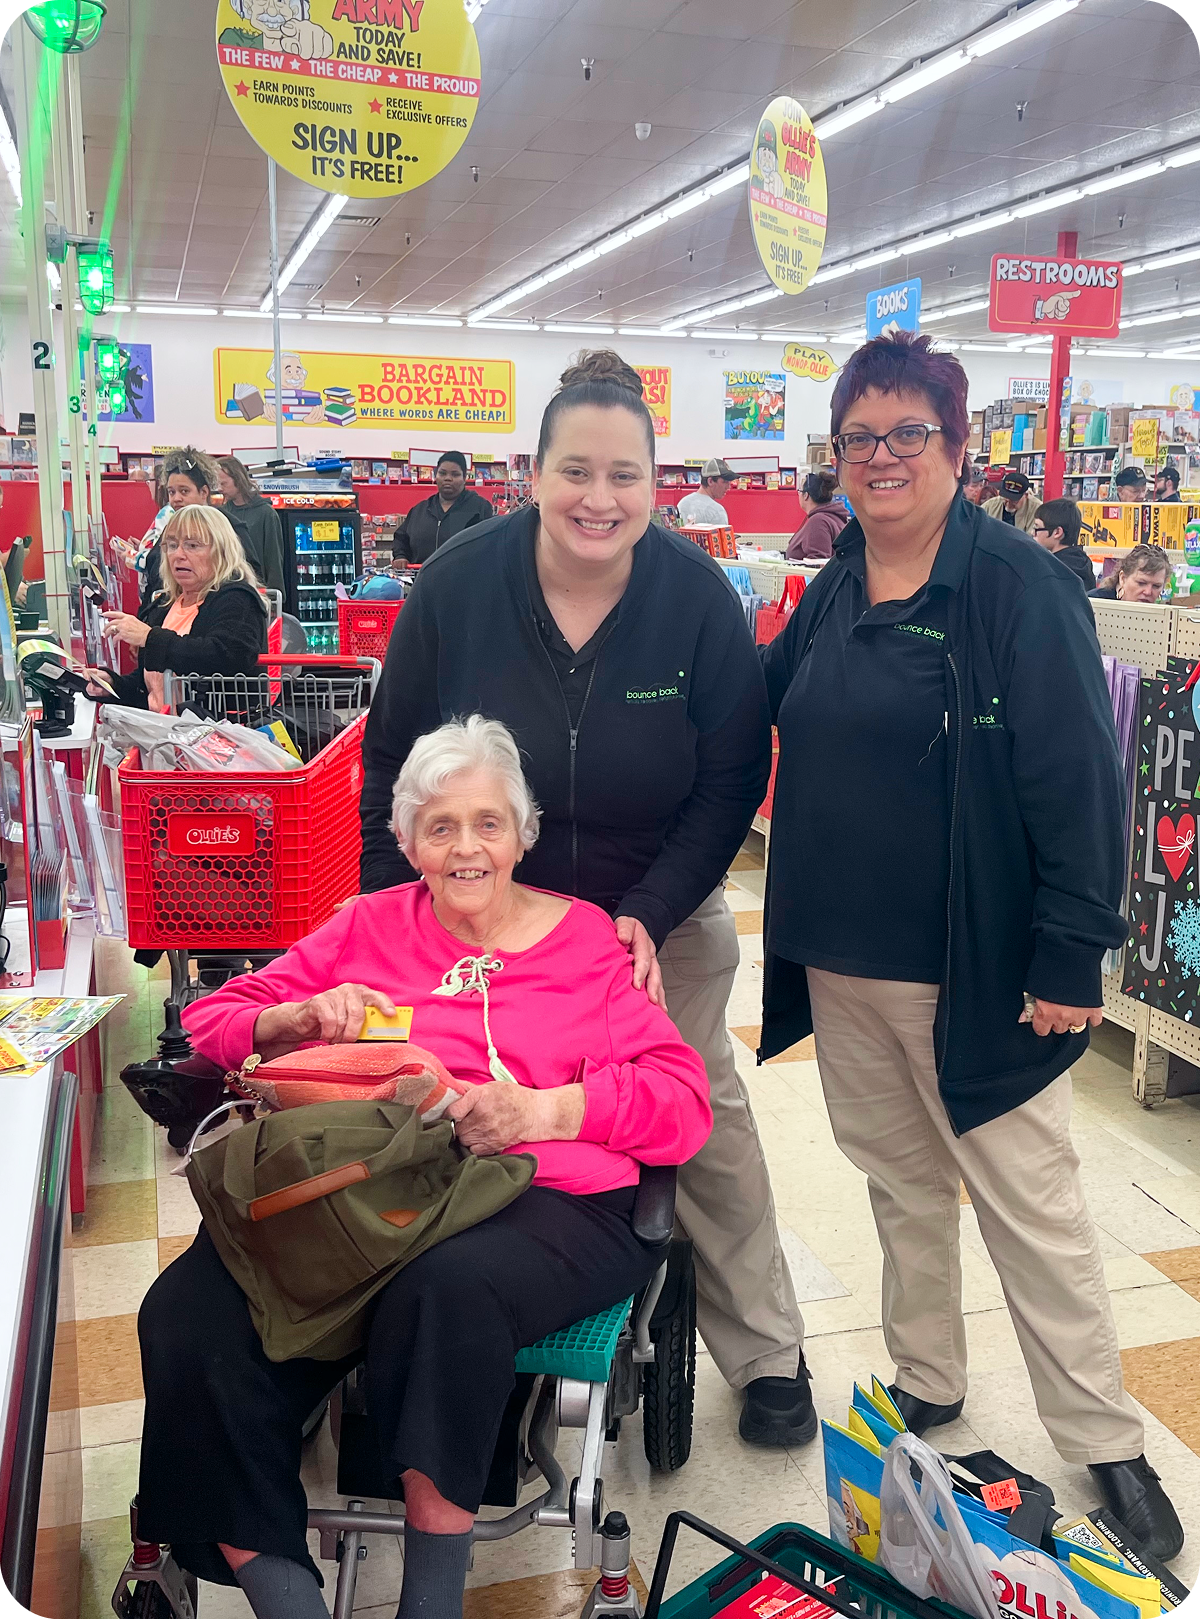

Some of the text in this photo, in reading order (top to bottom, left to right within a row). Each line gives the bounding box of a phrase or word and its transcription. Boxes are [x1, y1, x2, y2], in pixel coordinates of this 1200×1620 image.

[332, 0, 424, 32] ARMY
[353, 26, 406, 48] TODAY
[336, 42, 422, 68] AND SAVE!
[223, 48, 478, 95] THE FEW THE CHEAP THE PROUD
[253, 80, 315, 98] EARN POINTS
[253, 92, 353, 115] TOWARDS DISCOUNTS
[386, 98, 423, 111] RECEIVE
[386, 109, 468, 128] EXCLUSIVE OFFERS
[292, 122, 419, 163] SIGN UP...
[312, 155, 403, 184] IT'S FREE!
[784, 151, 812, 183] ARMY
[752, 188, 760, 200] THE
[790, 177, 806, 193] TODAY
[785, 187, 811, 207] AND SAVE!
[770, 240, 808, 271] SIGN UP...
[775, 263, 803, 285] IT'S FREE!
[996, 258, 1119, 289] RESTROOMS
[876, 286, 910, 319] BOOKS
[33, 342, 50, 370] 2
[793, 347, 826, 362] PLAY
[381, 362, 485, 387] BARGAIN
[1013, 380, 1033, 388] OLLIE'S
[69, 396, 81, 413] 3
[357, 383, 507, 408] BOOKLAND
[360, 407, 507, 422] WHERE WORDS ARE CHEAP!
[88, 424, 97, 437] 4
[923, 627, 946, 641] back
[626, 686, 679, 699] bounce back
